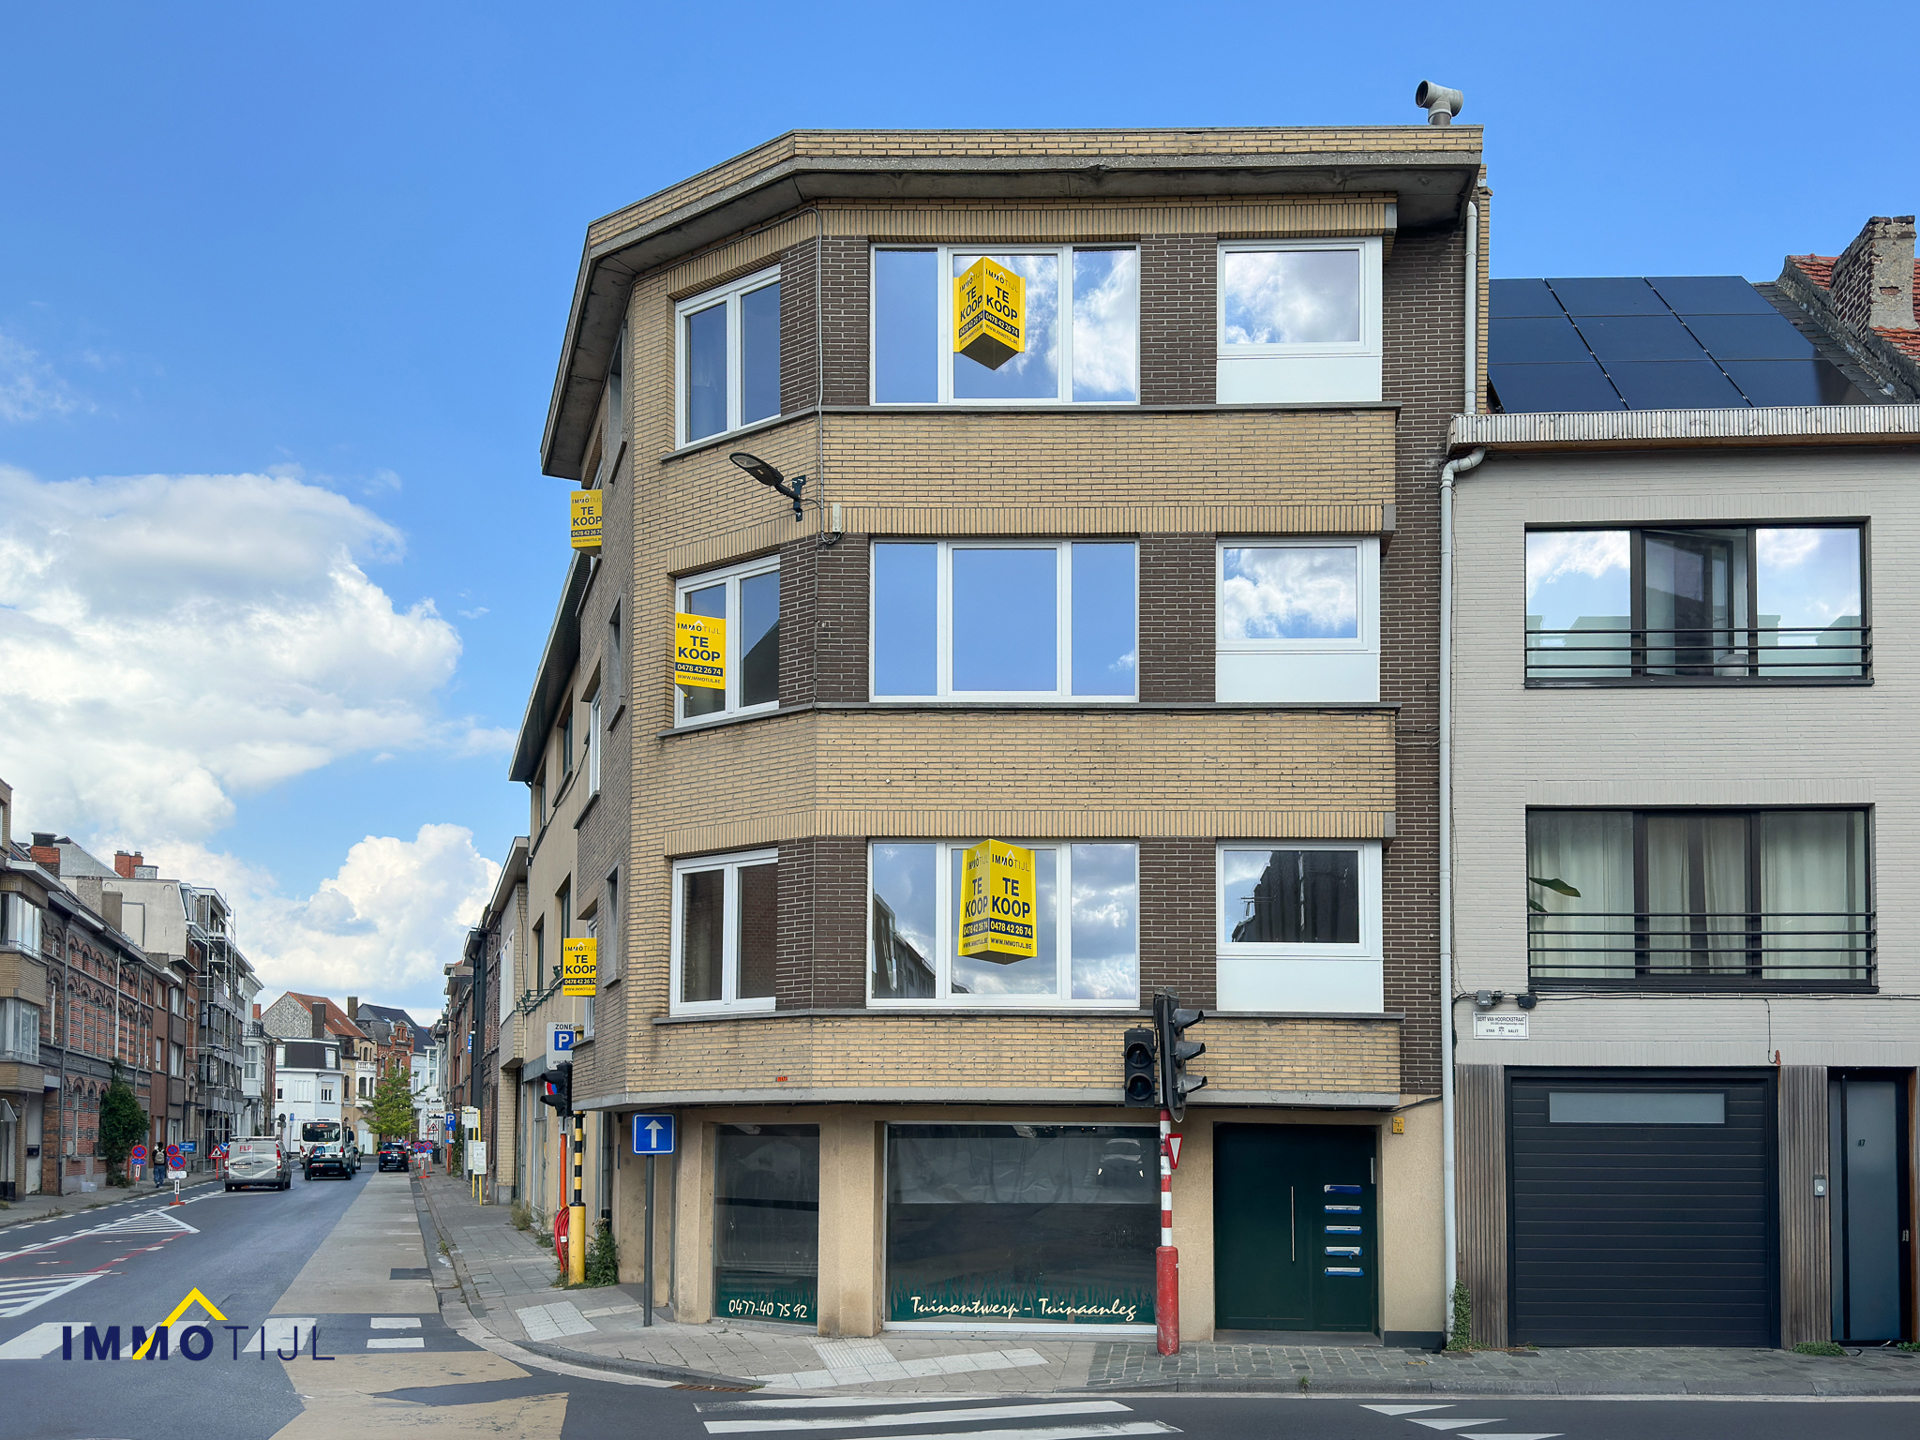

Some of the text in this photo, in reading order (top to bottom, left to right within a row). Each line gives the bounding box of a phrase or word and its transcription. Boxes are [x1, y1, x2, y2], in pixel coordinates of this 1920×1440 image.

[966, 286, 977, 303] TE
[995, 286, 1009, 304] TE
[960, 294, 983, 322] KOOP
[986, 294, 1018, 320] KOOP
[985, 312, 1018, 336] 0478 42 26 74
[581, 506, 594, 516] TE
[573, 516, 602, 526] KOOP
[677, 622, 721, 635] IMMOTIJL
[690, 635, 709, 648] TE
[678, 646, 721, 662] KOOP
[677, 664, 694, 672] 0478
[992, 854, 1030, 872] IMMOTIJL
[972, 877, 982, 895] TE
[1002, 877, 1019, 896] TE
[965, 896, 988, 918] KOOP
[992, 895, 1030, 918] KOOP
[991, 920, 1032, 936] 0478 42 26 74
[991, 937, 1032, 949] WWW.IMMOTIJL.BE
[574, 955, 588, 963] TE
[566, 965, 596, 974] KOOP
[559, 1034, 569, 1048] P
[448, 1115, 454, 1124] P
[728, 1299, 807, 1318] 0477-40 75 92
[910, 1296, 1019, 1319] Tuinontwerp
[1038, 1298, 1137, 1322] Tuinaanleg
